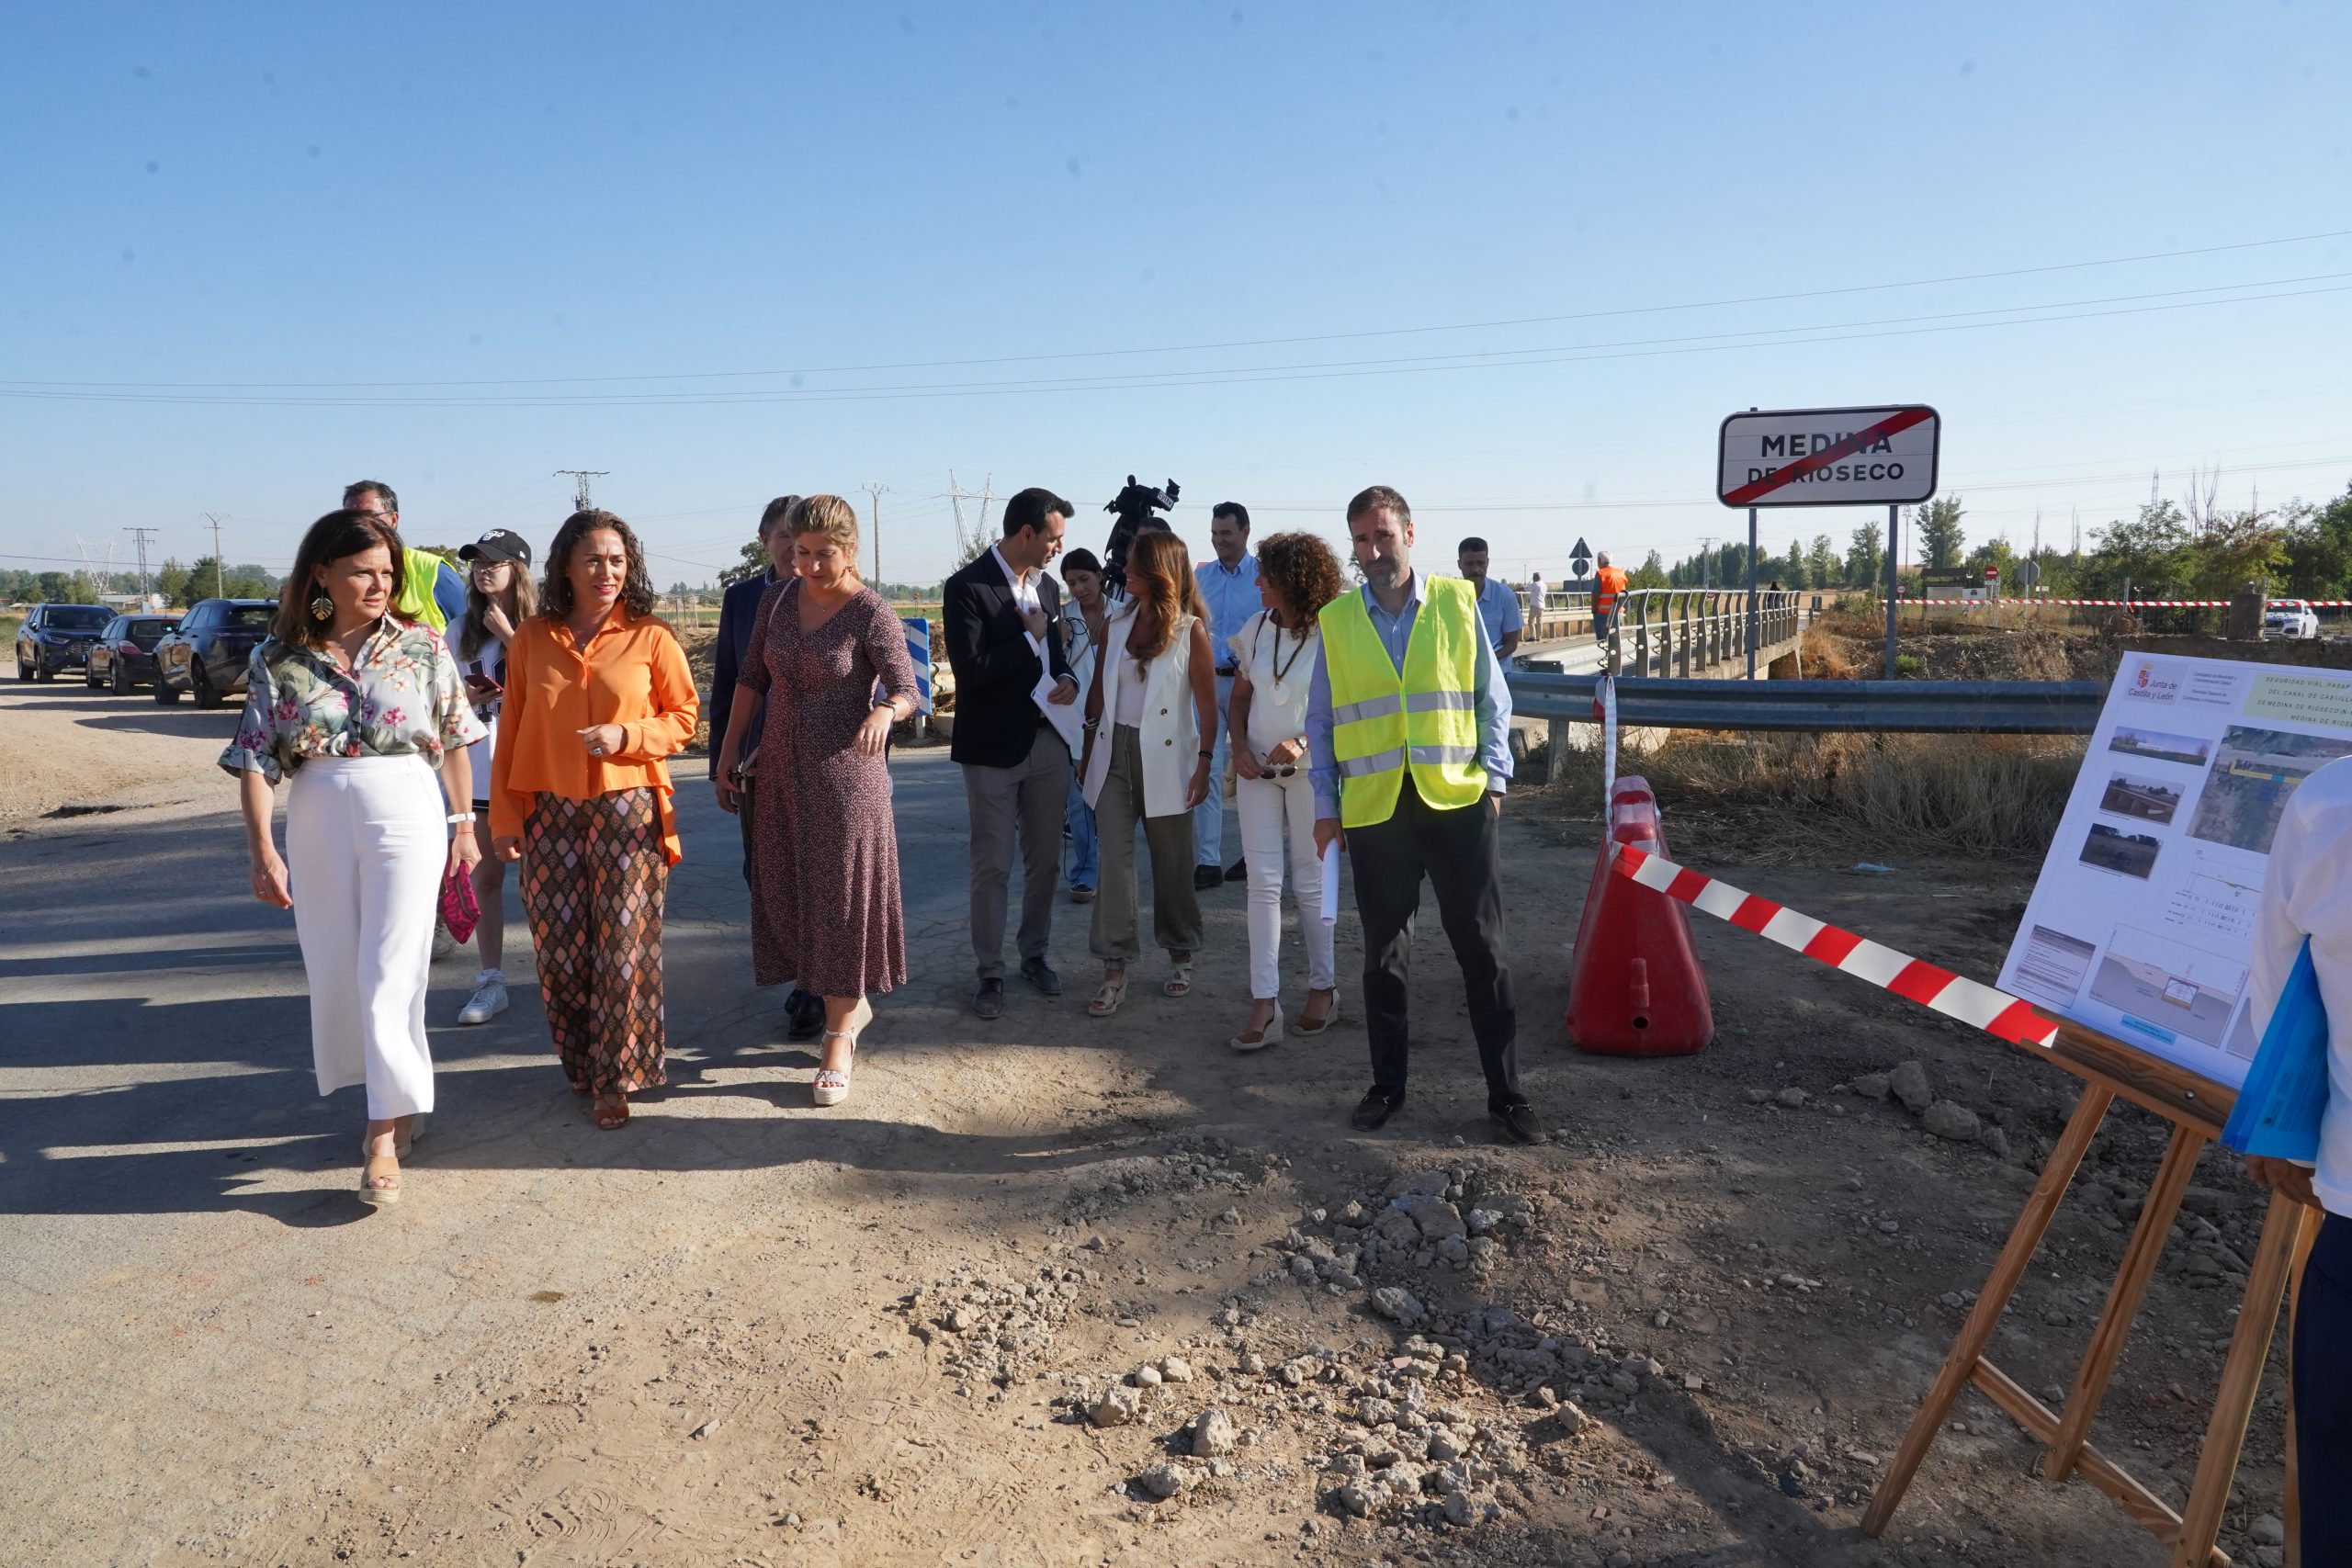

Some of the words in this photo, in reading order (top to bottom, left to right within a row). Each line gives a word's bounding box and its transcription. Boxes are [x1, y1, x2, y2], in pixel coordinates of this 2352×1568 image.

[1761, 430, 1892, 457] MEDINA
[1747, 467, 1778, 485] DE
[1792, 462, 1905, 483] RIOSECO
[2150, 680, 2168, 689] Junta
[2169, 682, 2177, 690] de
[2266, 676, 2305, 685] SEGURIDAD
[2128, 688, 2151, 698] Castilla
[2157, 692, 2174, 700] León
[2283, 690, 2305, 698] CANAL
[2307, 705, 2339, 715] RIOSECO
[2290, 715, 2316, 723] MEDINA
